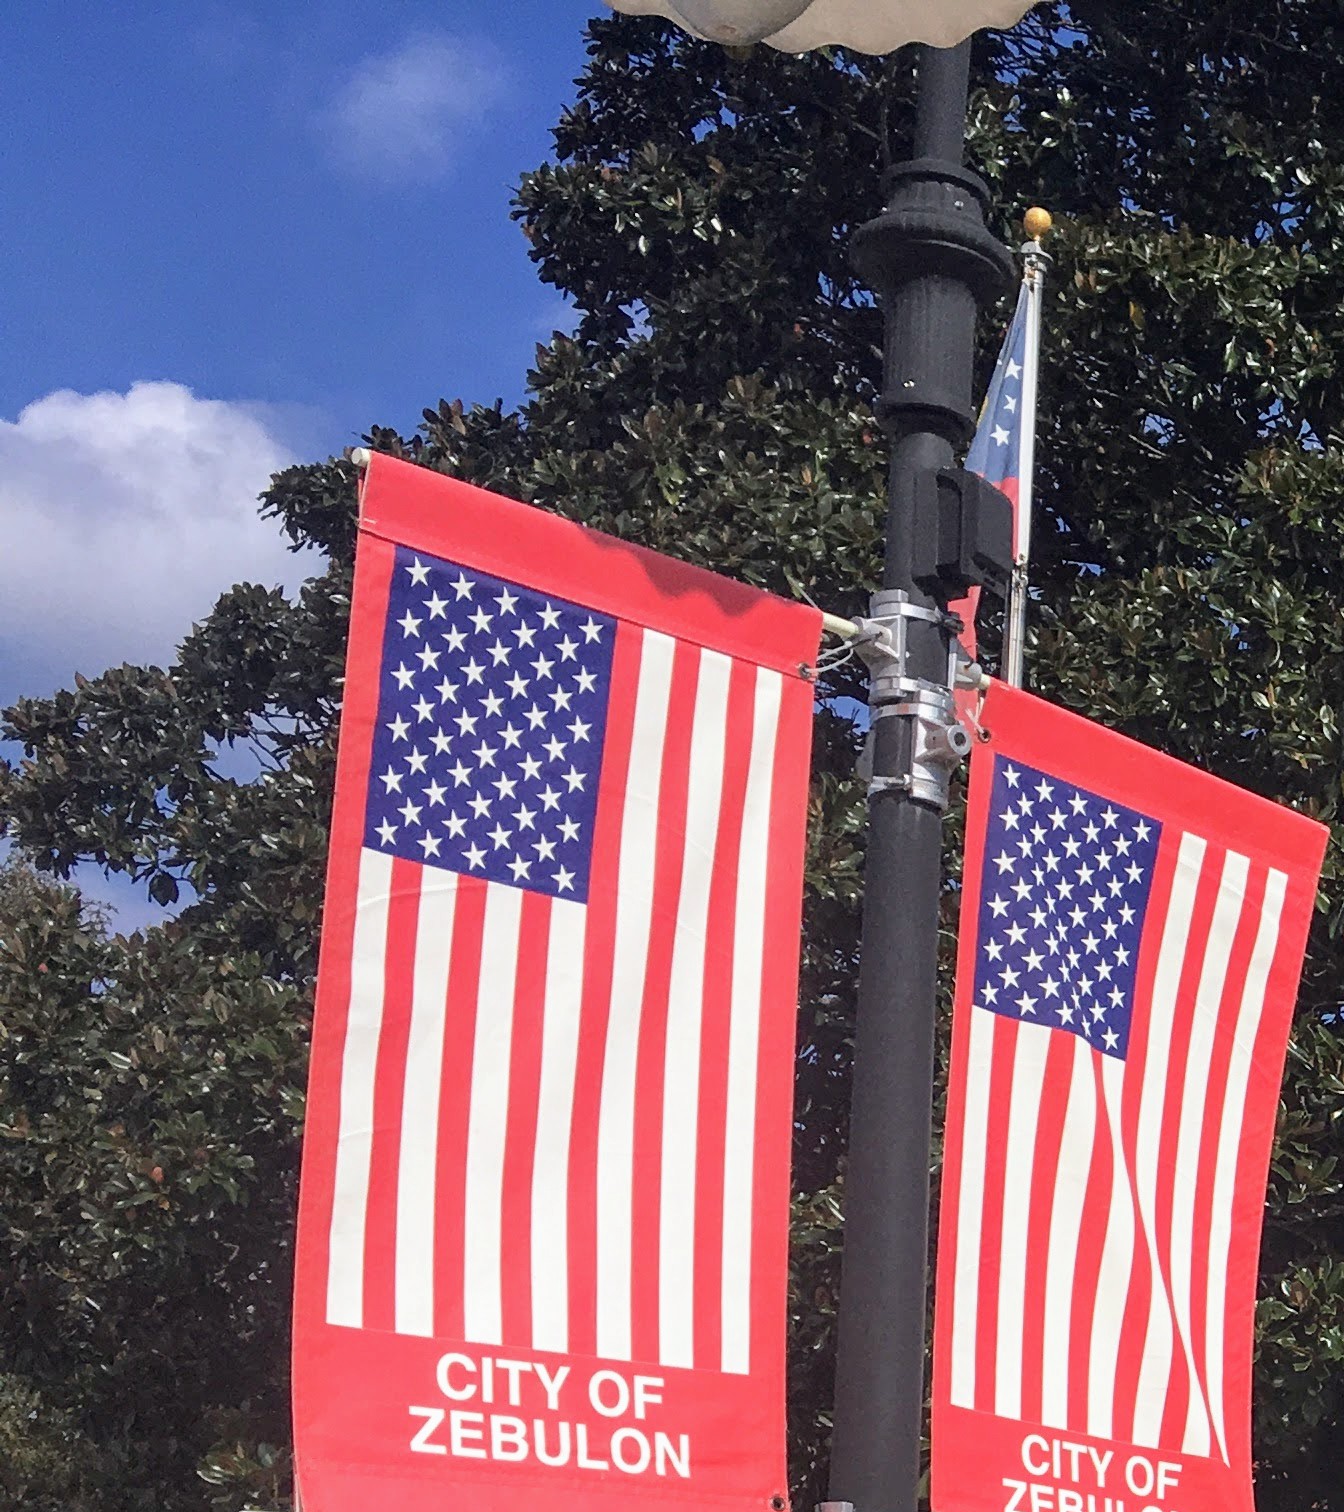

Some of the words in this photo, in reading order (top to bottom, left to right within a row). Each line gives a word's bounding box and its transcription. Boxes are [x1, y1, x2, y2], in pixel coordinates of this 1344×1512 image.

[435, 1352, 571, 1412] CITY
[588, 1370, 665, 1420] OF
[408, 1406, 691, 1479] ZEBULON
[1021, 1434, 1114, 1488] CITY
[1126, 1455, 1182, 1500] OF
